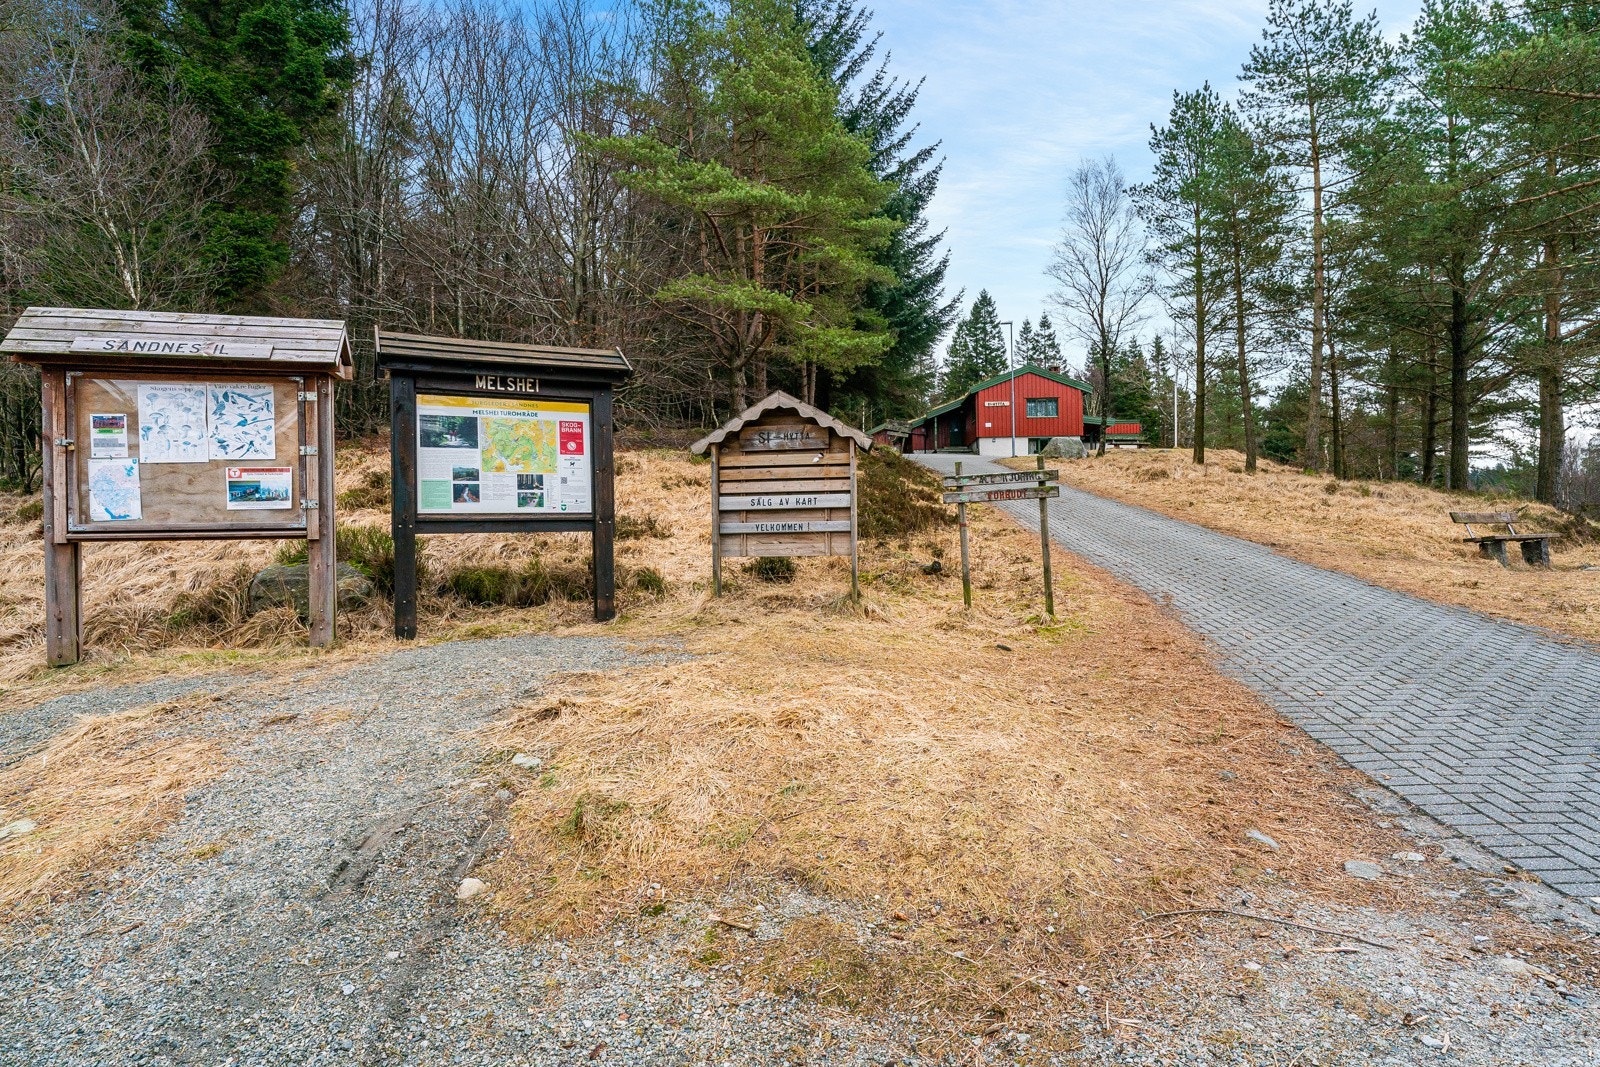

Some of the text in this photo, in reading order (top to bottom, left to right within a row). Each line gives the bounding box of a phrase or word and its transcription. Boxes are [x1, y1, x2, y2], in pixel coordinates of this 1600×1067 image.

[103, 339, 229, 355] SANDNES IL
[475, 375, 540, 392] MELSHEI
[500, 410, 539, 418] TUROMRÅDE
[779, 497, 790, 506] AV
[795, 497, 818, 506] KART
[755, 523, 804, 531] VELKOMMEN
